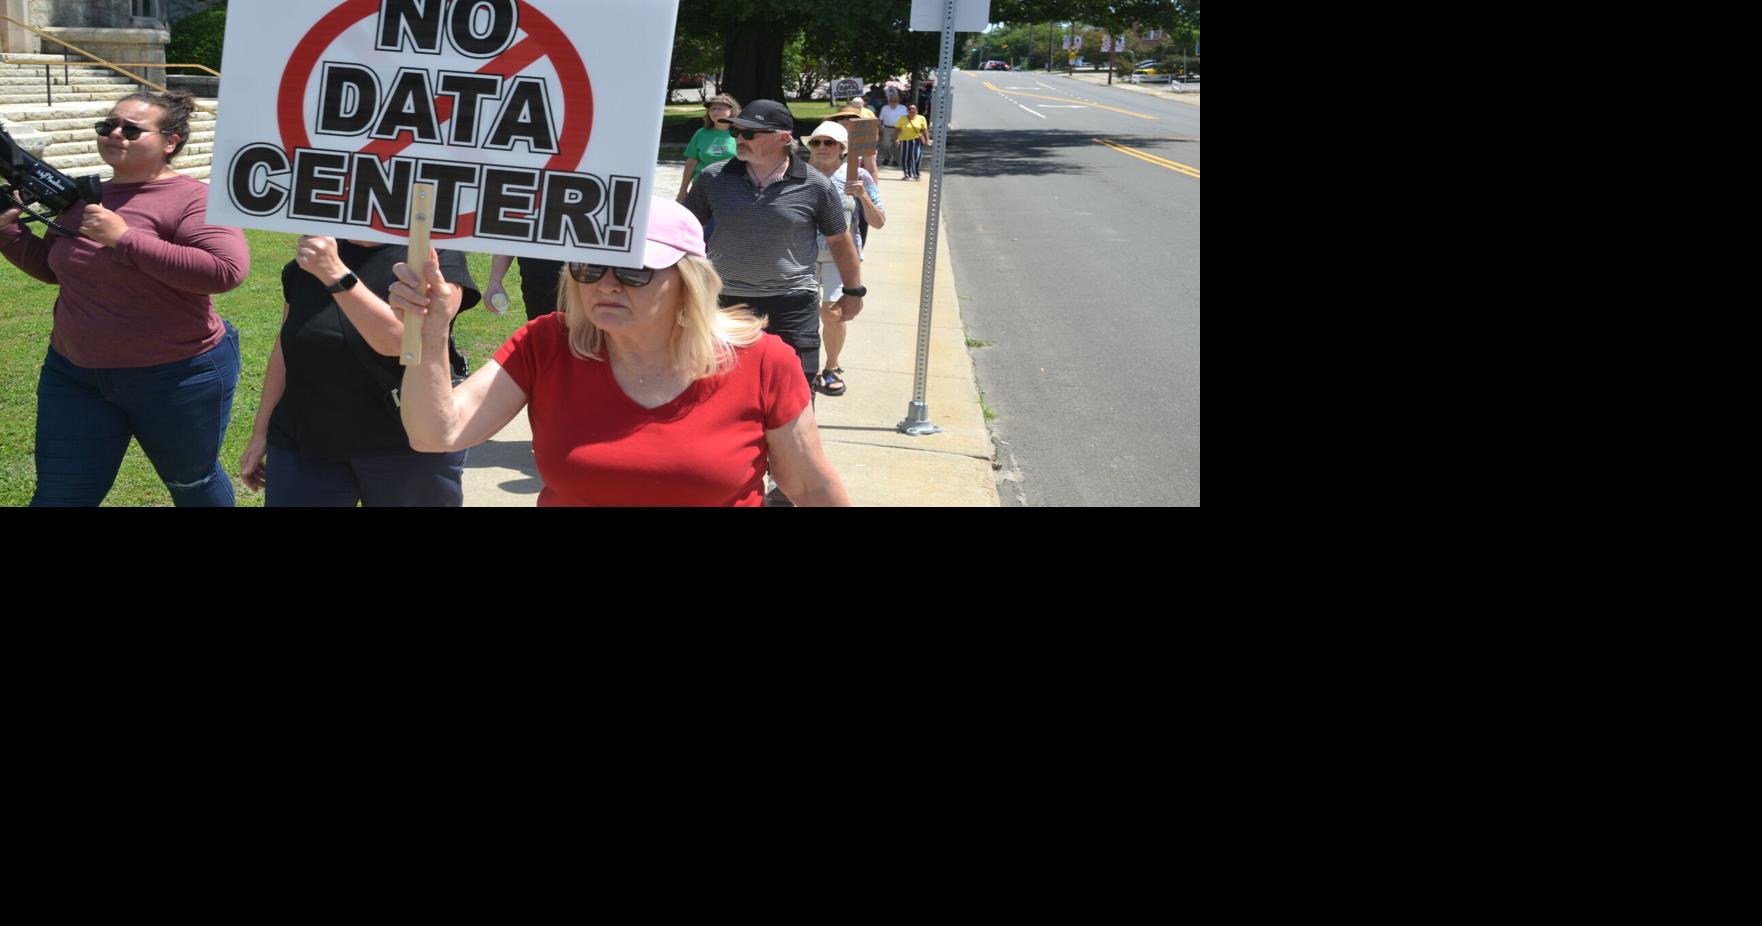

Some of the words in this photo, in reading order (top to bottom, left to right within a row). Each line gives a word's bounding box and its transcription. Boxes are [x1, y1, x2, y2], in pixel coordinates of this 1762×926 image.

[375, 0, 520, 59] NO
[316, 61, 559, 154] DATA
[228, 142, 640, 251] CENTER!
